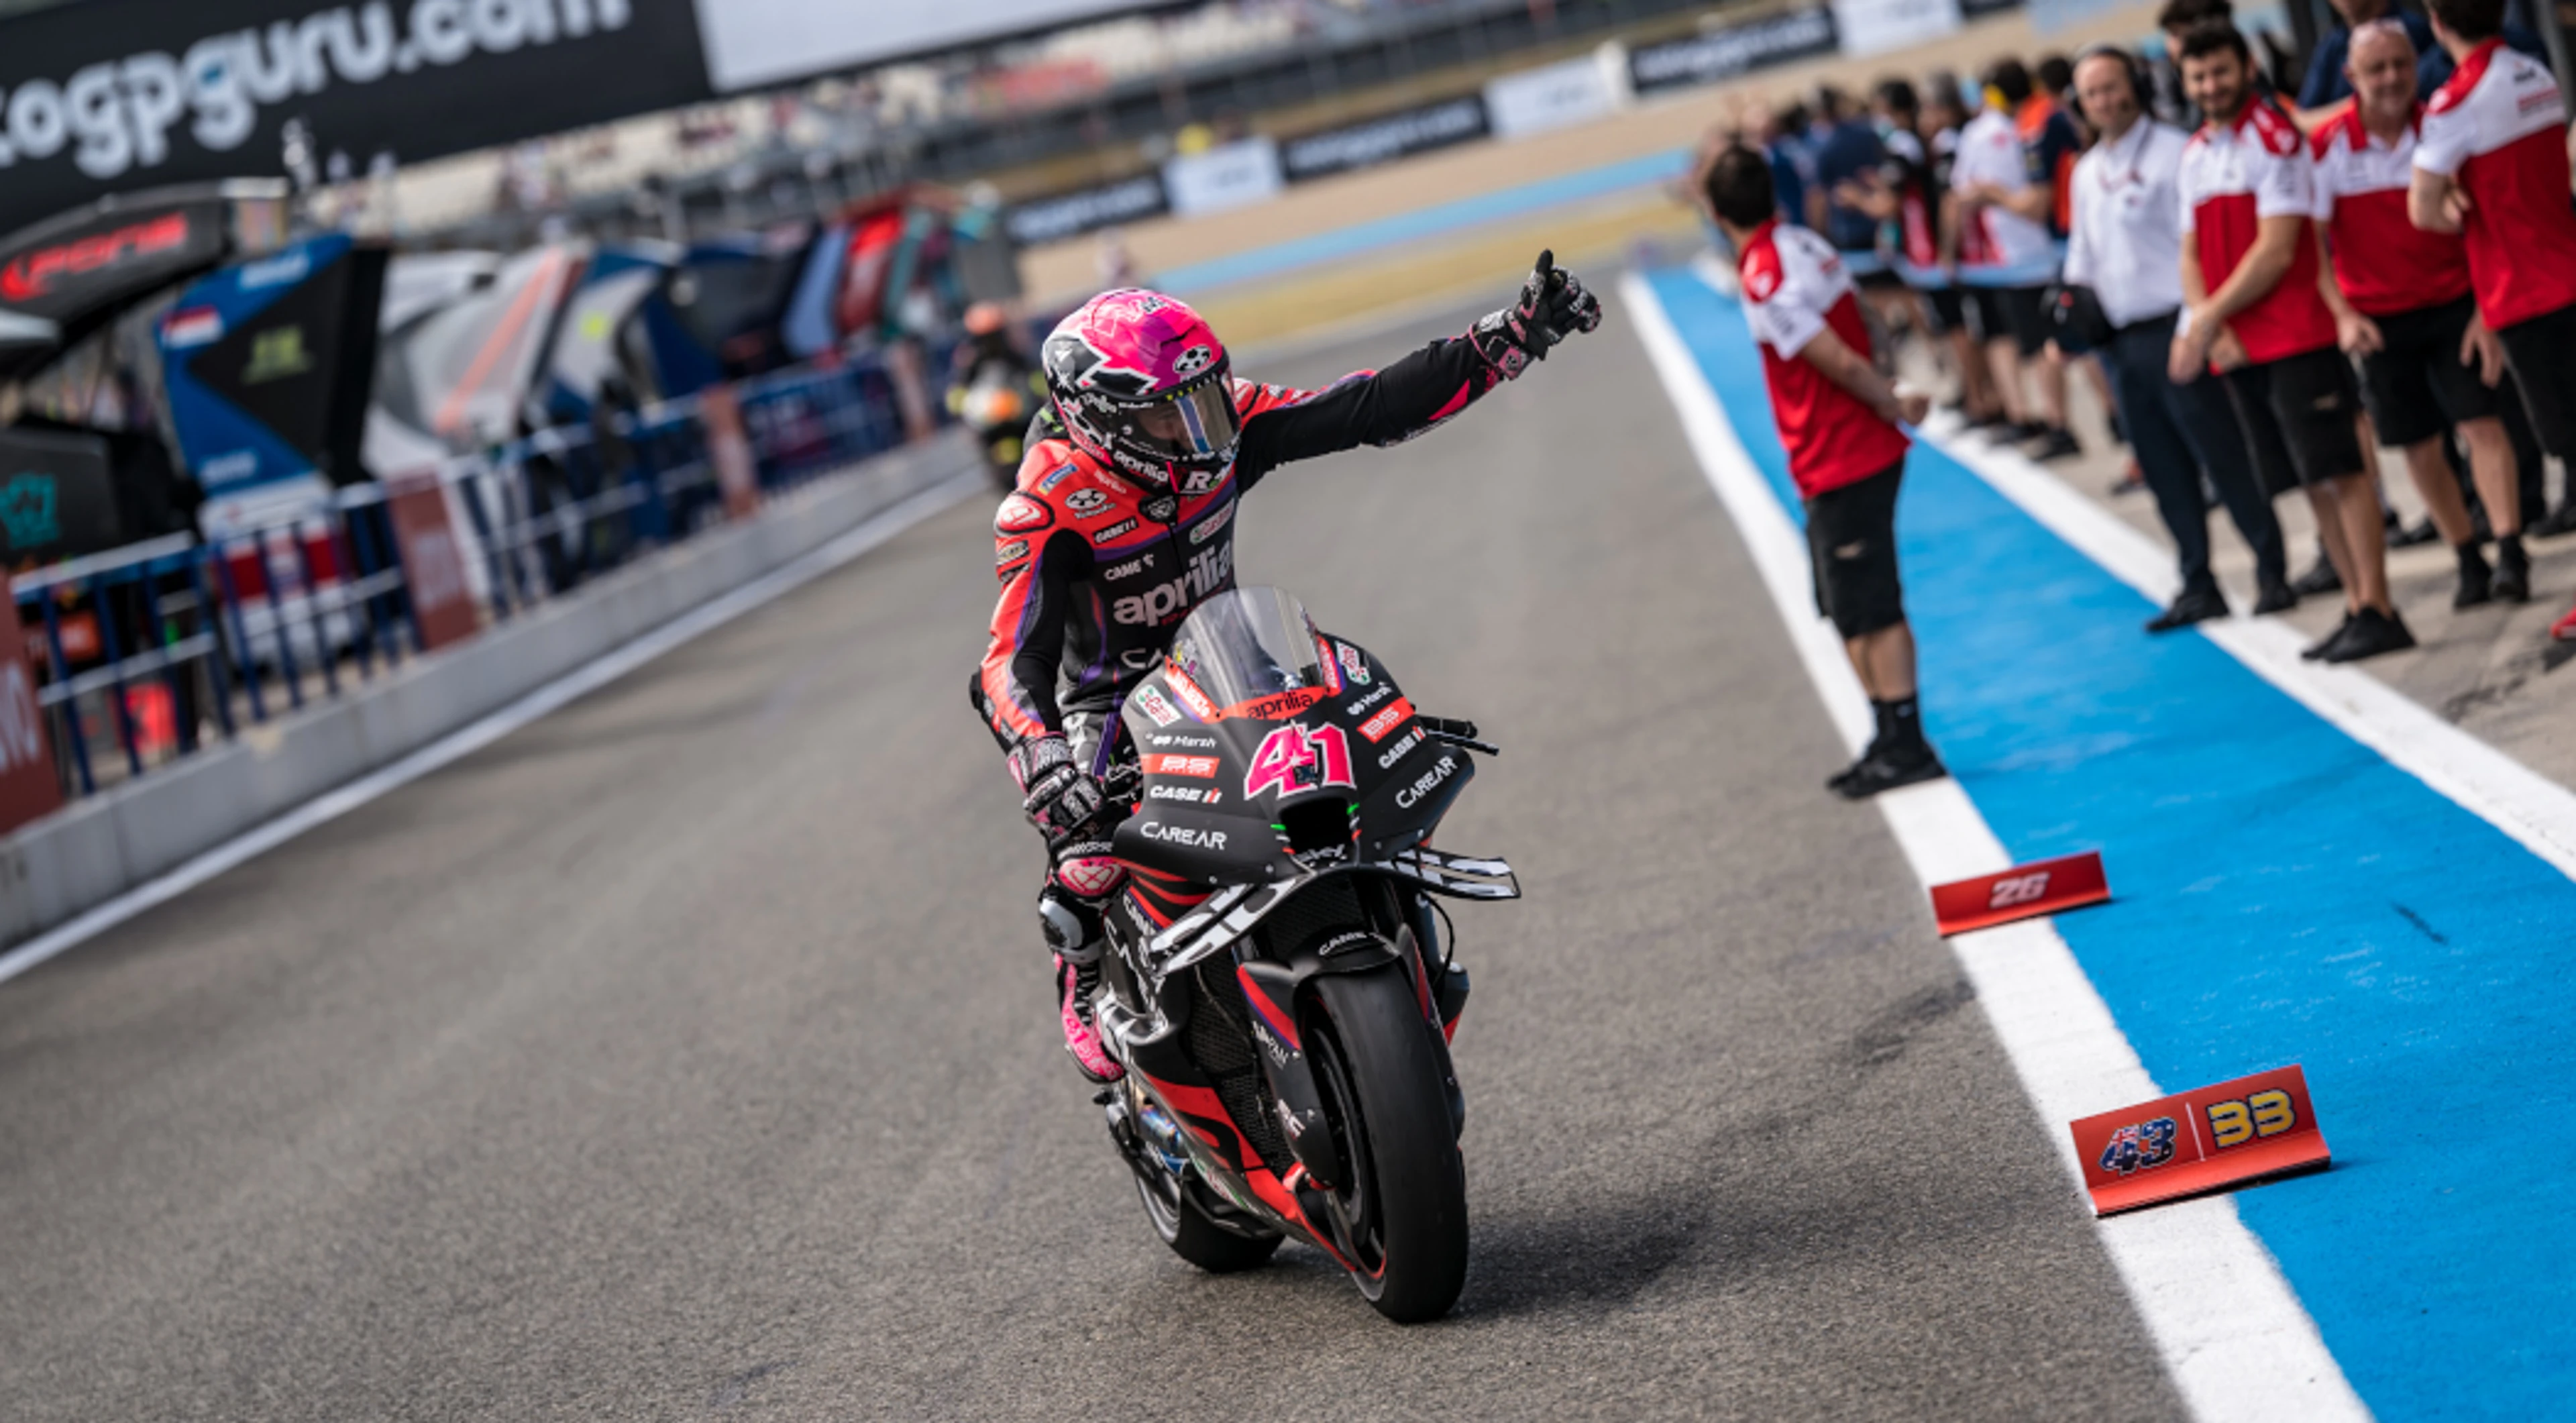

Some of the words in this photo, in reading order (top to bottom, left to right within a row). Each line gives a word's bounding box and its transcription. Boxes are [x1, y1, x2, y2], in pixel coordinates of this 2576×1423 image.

[0, 0, 632, 178] ogpguru.com
[1104, 559, 1142, 581] CAME
[1113, 539, 1232, 627] aprilia
[1246, 691, 1314, 719] aprilia
[1173, 736, 1218, 749] Marsh
[1243, 721, 1358, 801] 41
[1150, 785, 1203, 802] CASE
[1395, 755, 1458, 809] CAREAR
[1140, 821, 1228, 851] CAREAR
[1990, 872, 2051, 908] 26
[2207, 1089, 2298, 1149] 33
[2098, 1116, 2178, 1176] 43
